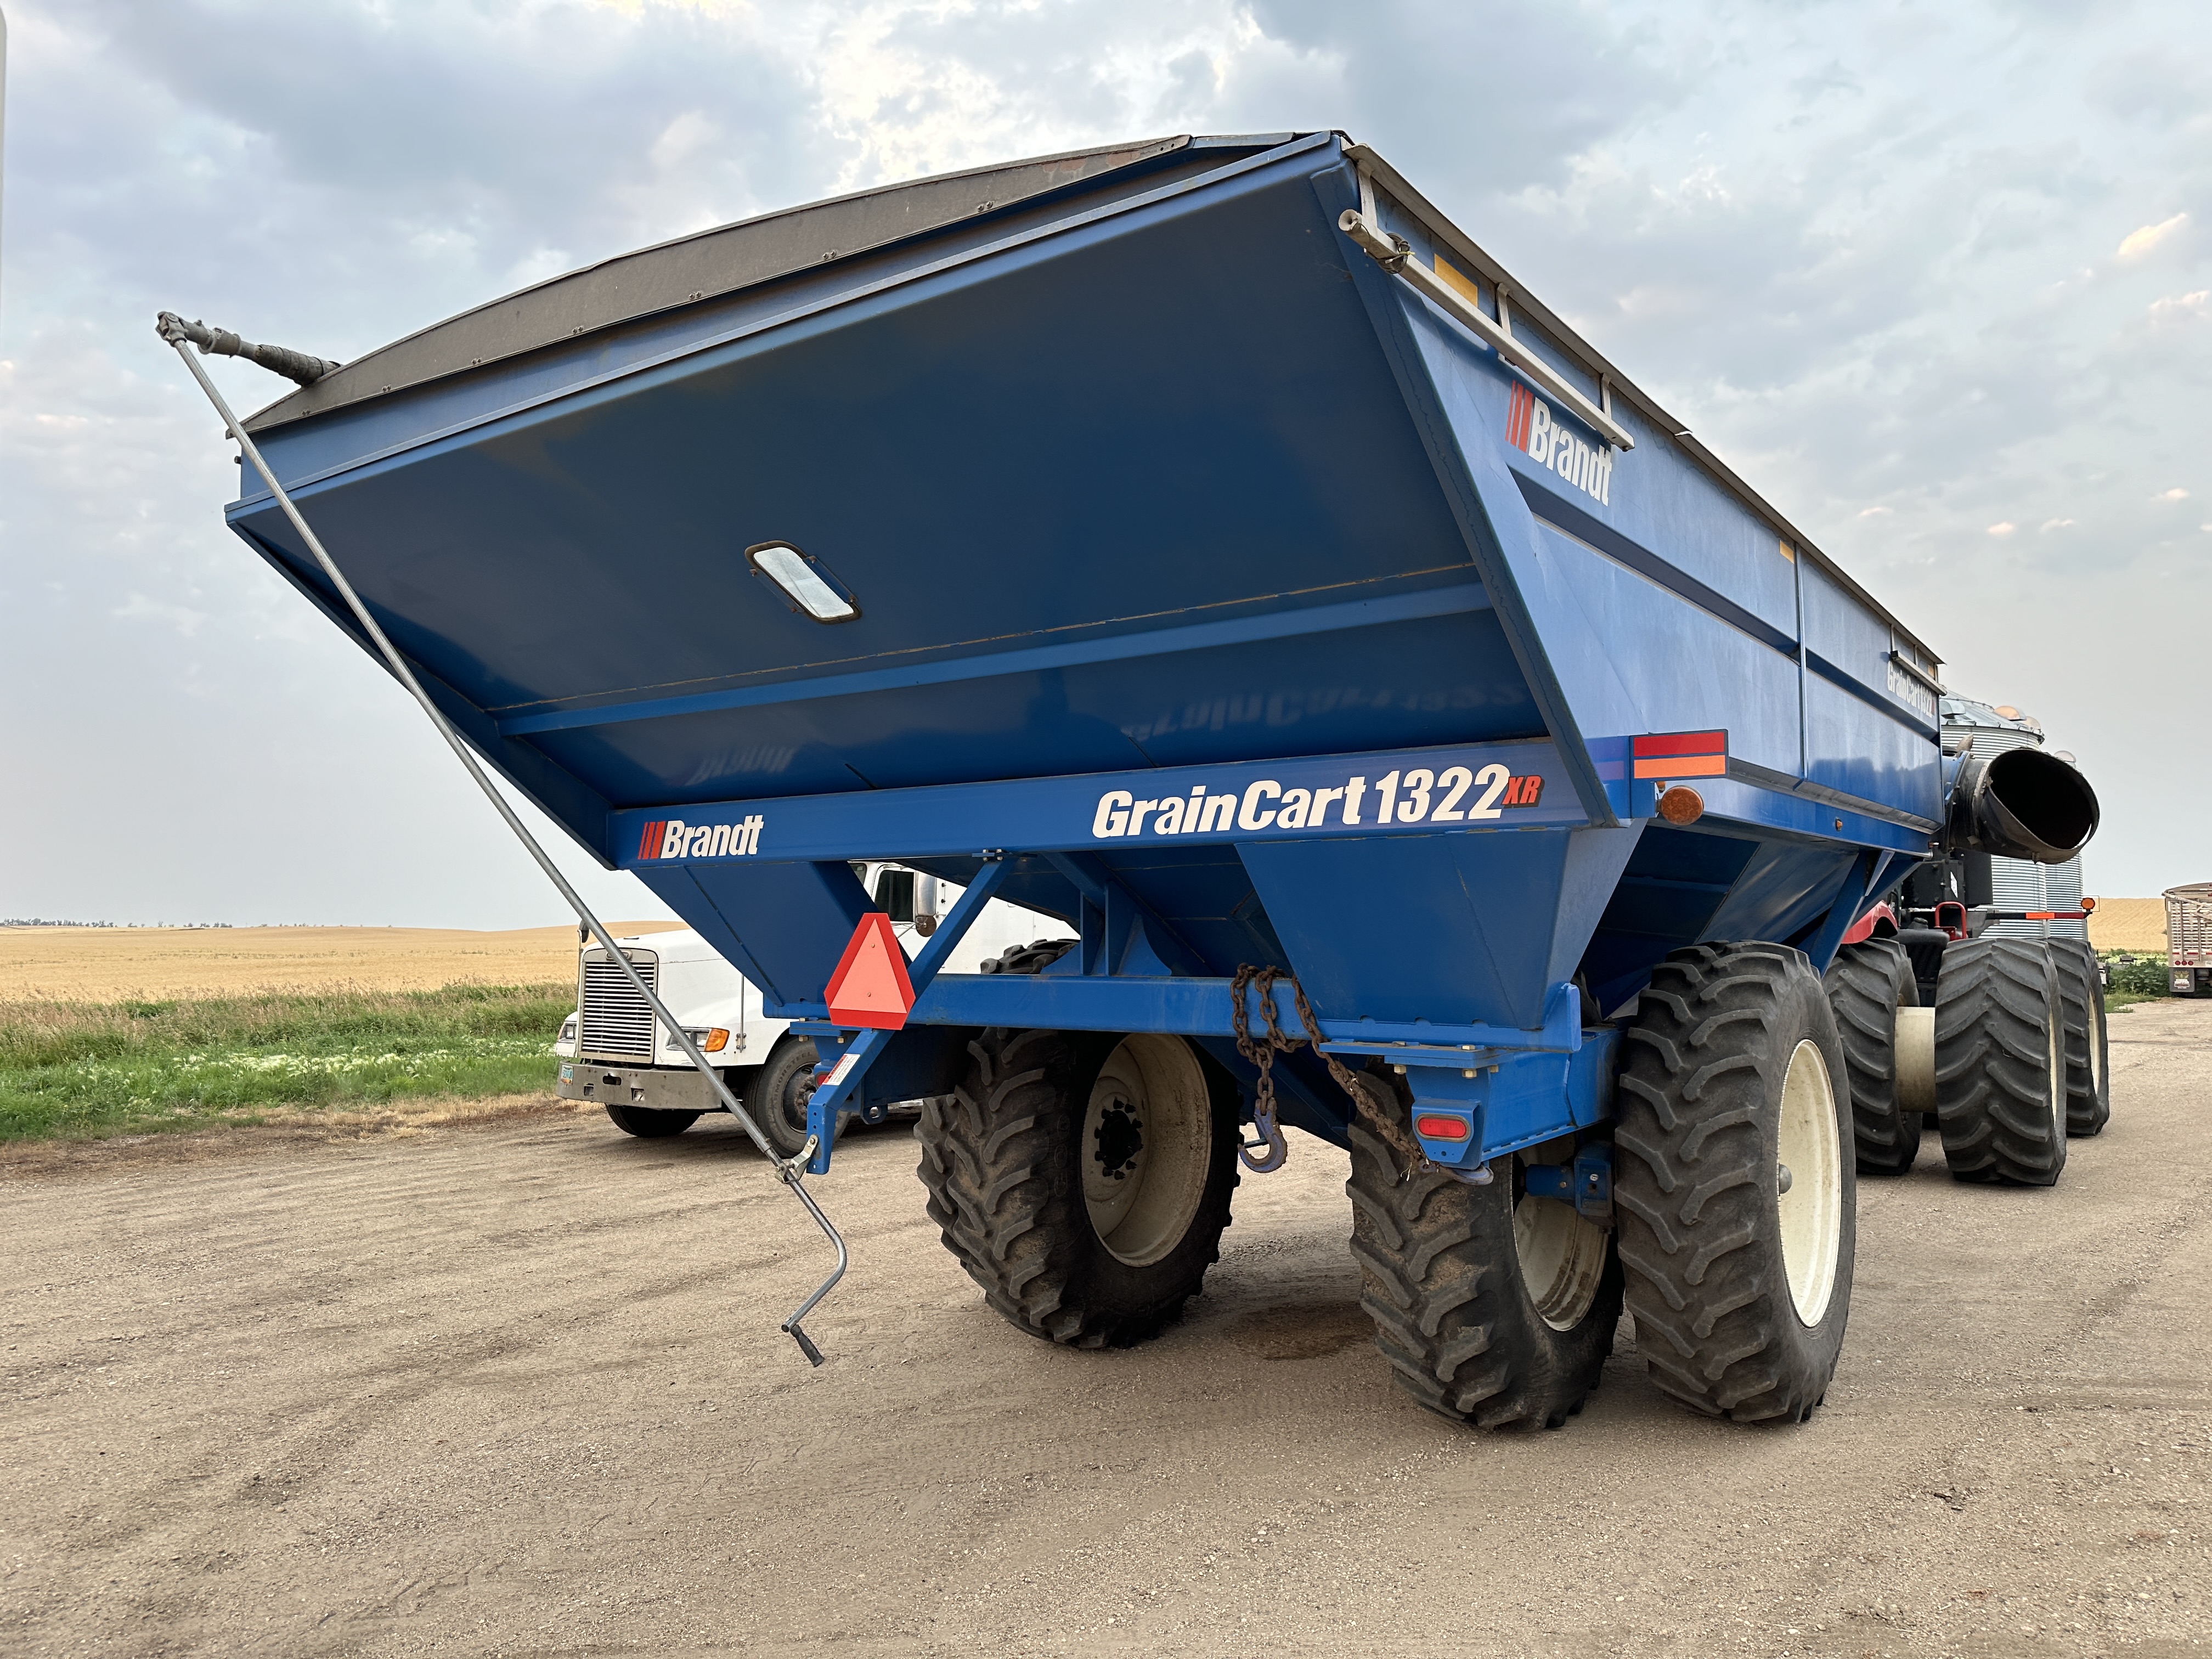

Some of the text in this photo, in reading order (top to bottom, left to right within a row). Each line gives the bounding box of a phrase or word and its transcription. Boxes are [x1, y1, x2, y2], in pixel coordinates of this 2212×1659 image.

[1528, 396, 1612, 507] Brandt
[1887, 661, 1933, 719] GrainCart 1322
[660, 815, 765, 859] Brandt
[1092, 776, 1367, 838] GrainCart
